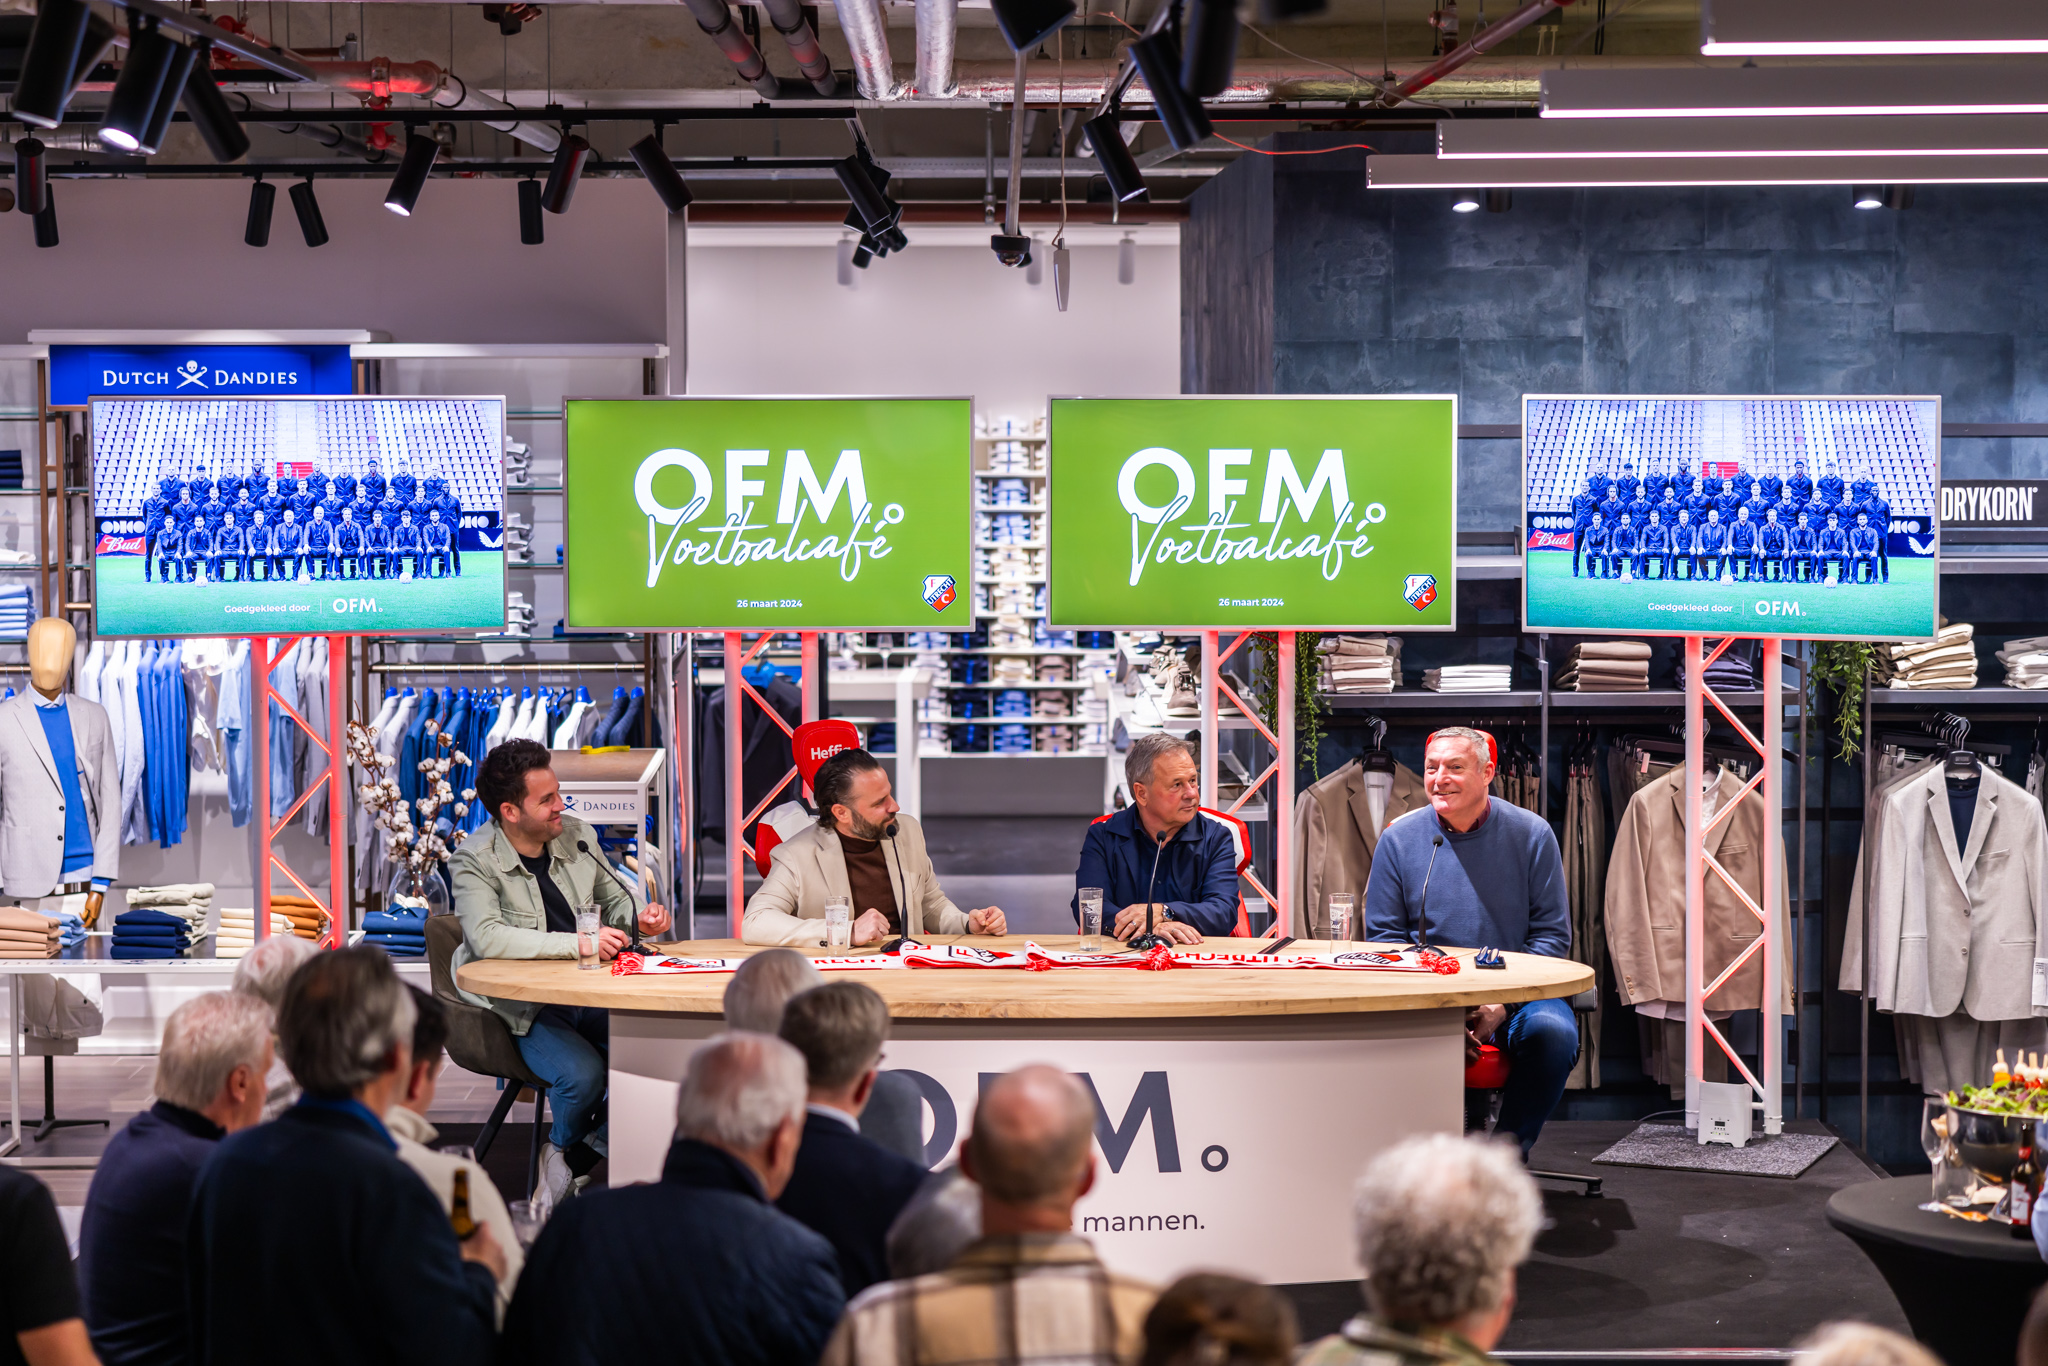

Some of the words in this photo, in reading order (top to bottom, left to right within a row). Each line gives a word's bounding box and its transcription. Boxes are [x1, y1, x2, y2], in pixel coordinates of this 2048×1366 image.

[103, 370, 169, 386] DUTCH
[215, 369, 298, 386] DANDIES
[104, 536, 142, 551] Bud
[1535, 531, 1571, 546] Bud
[926, 577, 954, 605] UTRECHT
[1407, 576, 1435, 604] UTRECHT
[224, 603, 287, 614] Goedgekleed
[289, 603, 311, 613] door
[736, 599, 749, 608] 26
[750, 600, 778, 608] maart
[780, 599, 803, 608] 2024
[1218, 598, 1230, 607] 26
[1231, 599, 1260, 607] maart
[1261, 598, 1285, 607] 2024
[1647, 602, 1709, 613] Goedgekleed
[1711, 603, 1733, 612] door
[811, 744, 851, 760] Heffi
[583, 801, 635, 811] DANDIES
[1083, 1214, 1205, 1233] mannen.
